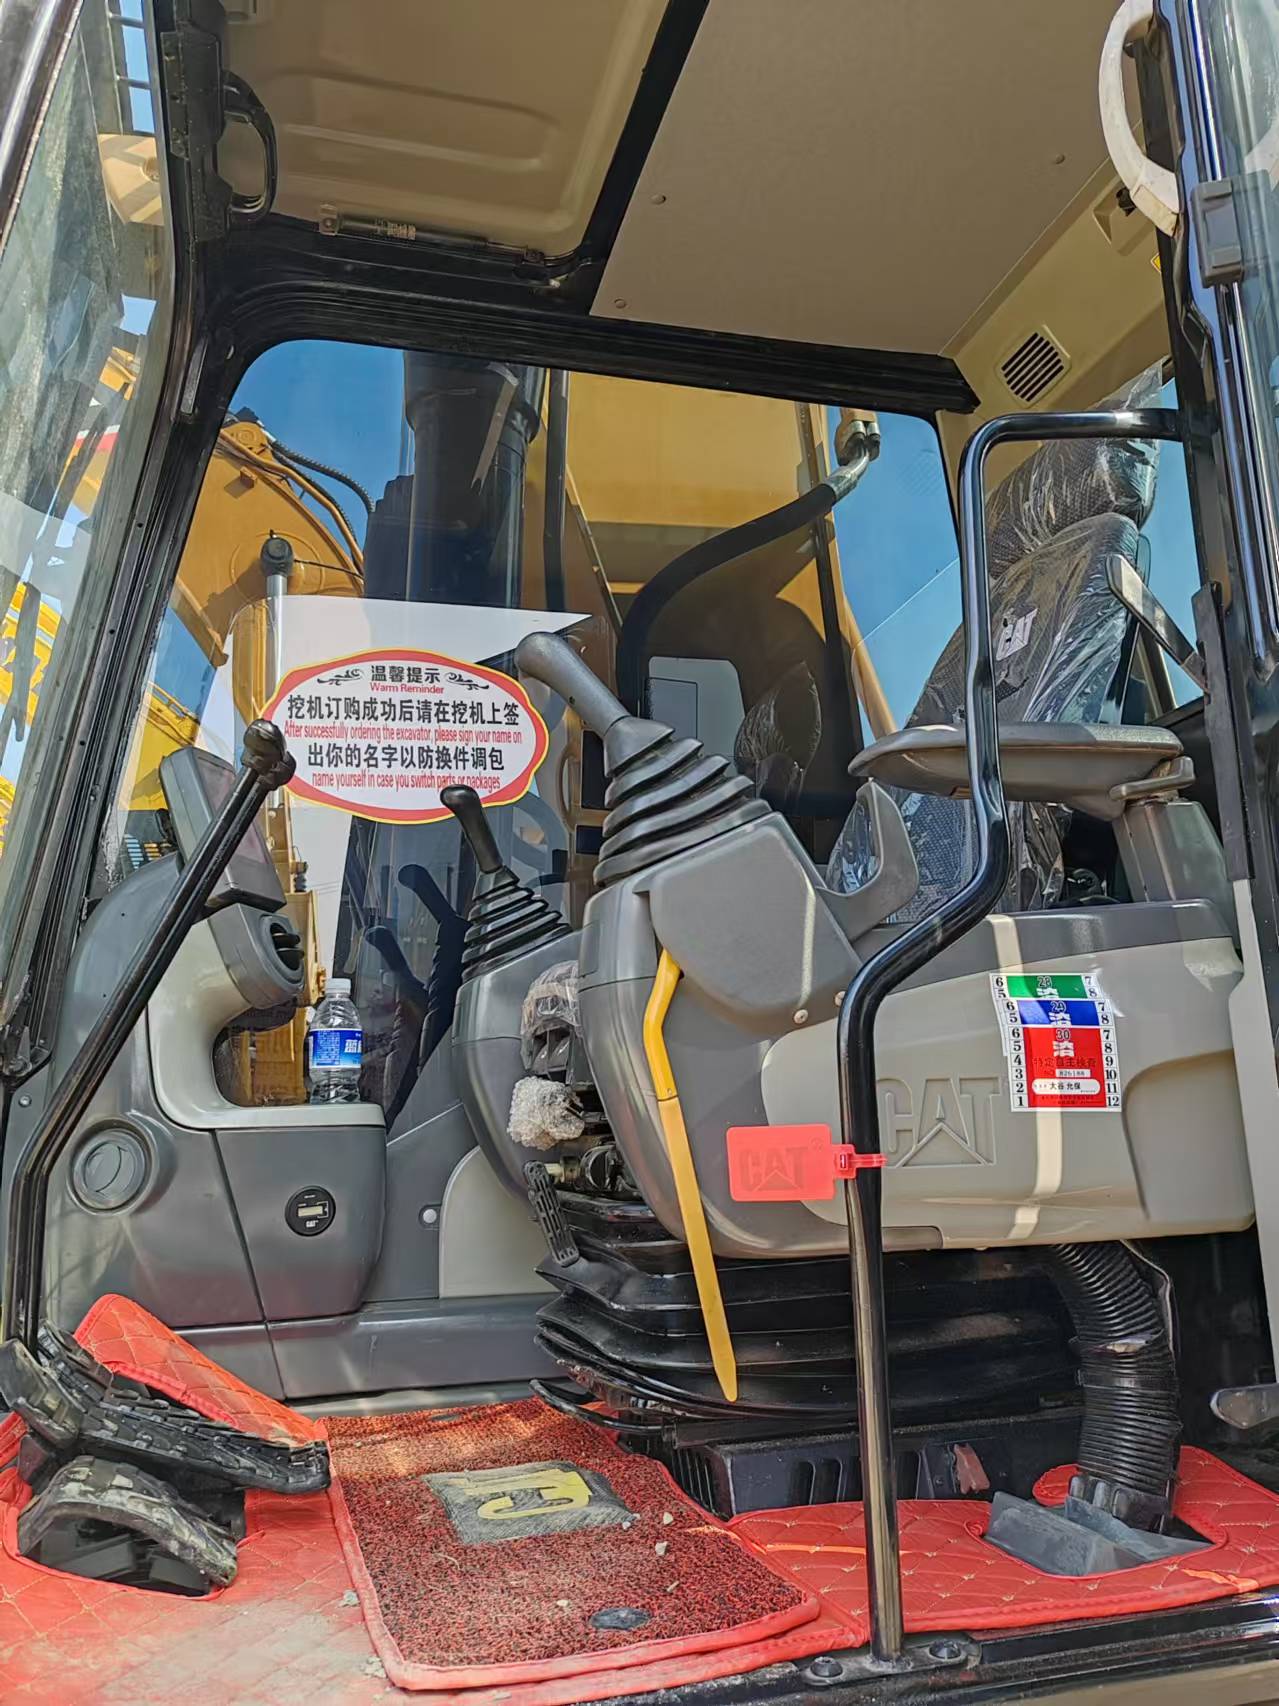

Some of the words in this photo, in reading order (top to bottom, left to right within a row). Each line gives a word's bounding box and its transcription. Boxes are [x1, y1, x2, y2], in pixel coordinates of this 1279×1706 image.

[371, 665, 441, 683] 温馨提示
[370, 682, 399, 693] Warm
[400, 684, 445, 694] Reminder
[288, 694, 519, 725] 挖机订购成功后请在挖机上签
[284, 720, 302, 737] After
[304, 721, 348, 742] successfully
[350, 722, 381, 744] ordering
[383, 723, 394, 740] the
[434, 725, 457, 745] please
[459, 726, 473, 745] sign
[475, 729, 490, 745] your
[492, 730, 512, 743] name
[513, 731, 523, 743] on
[308, 742, 504, 770] 出你的名字以防换件调包
[312, 772, 334, 787] name
[336, 768, 366, 791] yourself
[368, 770, 374, 787] in
[376, 773, 394, 788] case
[395, 774, 410, 791] you
[411, 770, 435, 788] switch
[996, 977, 1003, 987] 6
[1085, 976, 1091, 985] 7
[1007, 1002, 1015, 1011] 6
[1098, 1002, 1105, 1011] 7
[1010, 1013, 1017, 1023] 5
[1101, 1014, 1109, 1025] 8
[1012, 1028, 1020, 1038] 6
[1056, 1029, 1070, 1040] 30
[1103, 1029, 1111, 1040] 7
[1013, 1041, 1022, 1052] 5
[1105, 1042, 1112, 1053] 8
[1014, 1054, 1022, 1065] 4
[1106, 1056, 1114, 1067] 9
[1015, 1069, 1023, 1079] 3
[1105, 1070, 1117, 1080] 10
[1016, 1083, 1024, 1093] 2
[1107, 1083, 1118, 1093] 11
[1018, 1096, 1023, 1107] 1
[1108, 1096, 1119, 1107] 12
[876, 1076, 1000, 1169] CAT
[741, 1146, 809, 1192] CAT
